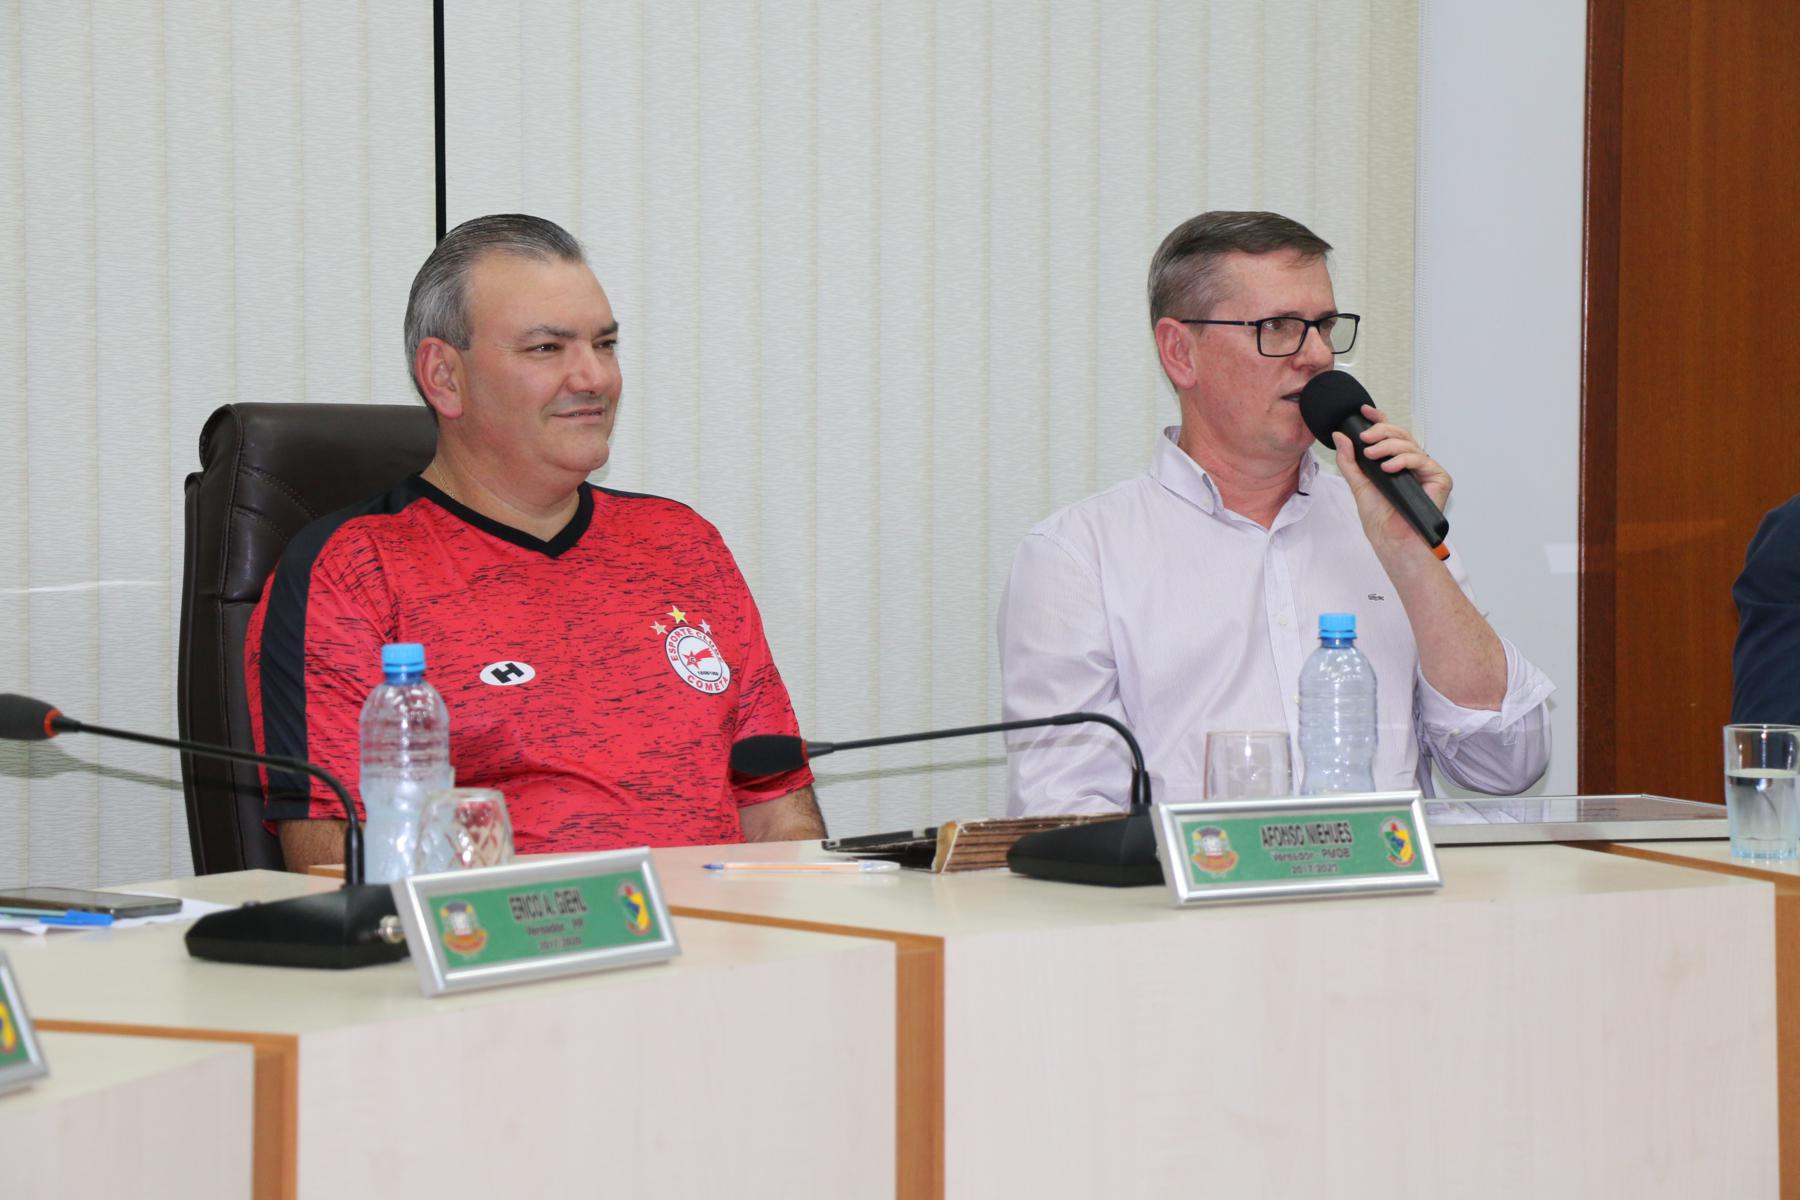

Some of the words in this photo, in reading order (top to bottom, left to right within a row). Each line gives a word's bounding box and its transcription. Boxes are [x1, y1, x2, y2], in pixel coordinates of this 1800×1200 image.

[668, 628, 692, 662] ESPORTE
[490, 662, 525, 684] H
[687, 675, 728, 691] COMETA
[1261, 825, 1305, 848] AFONSO
[1305, 822, 1352, 844] NIEHUES
